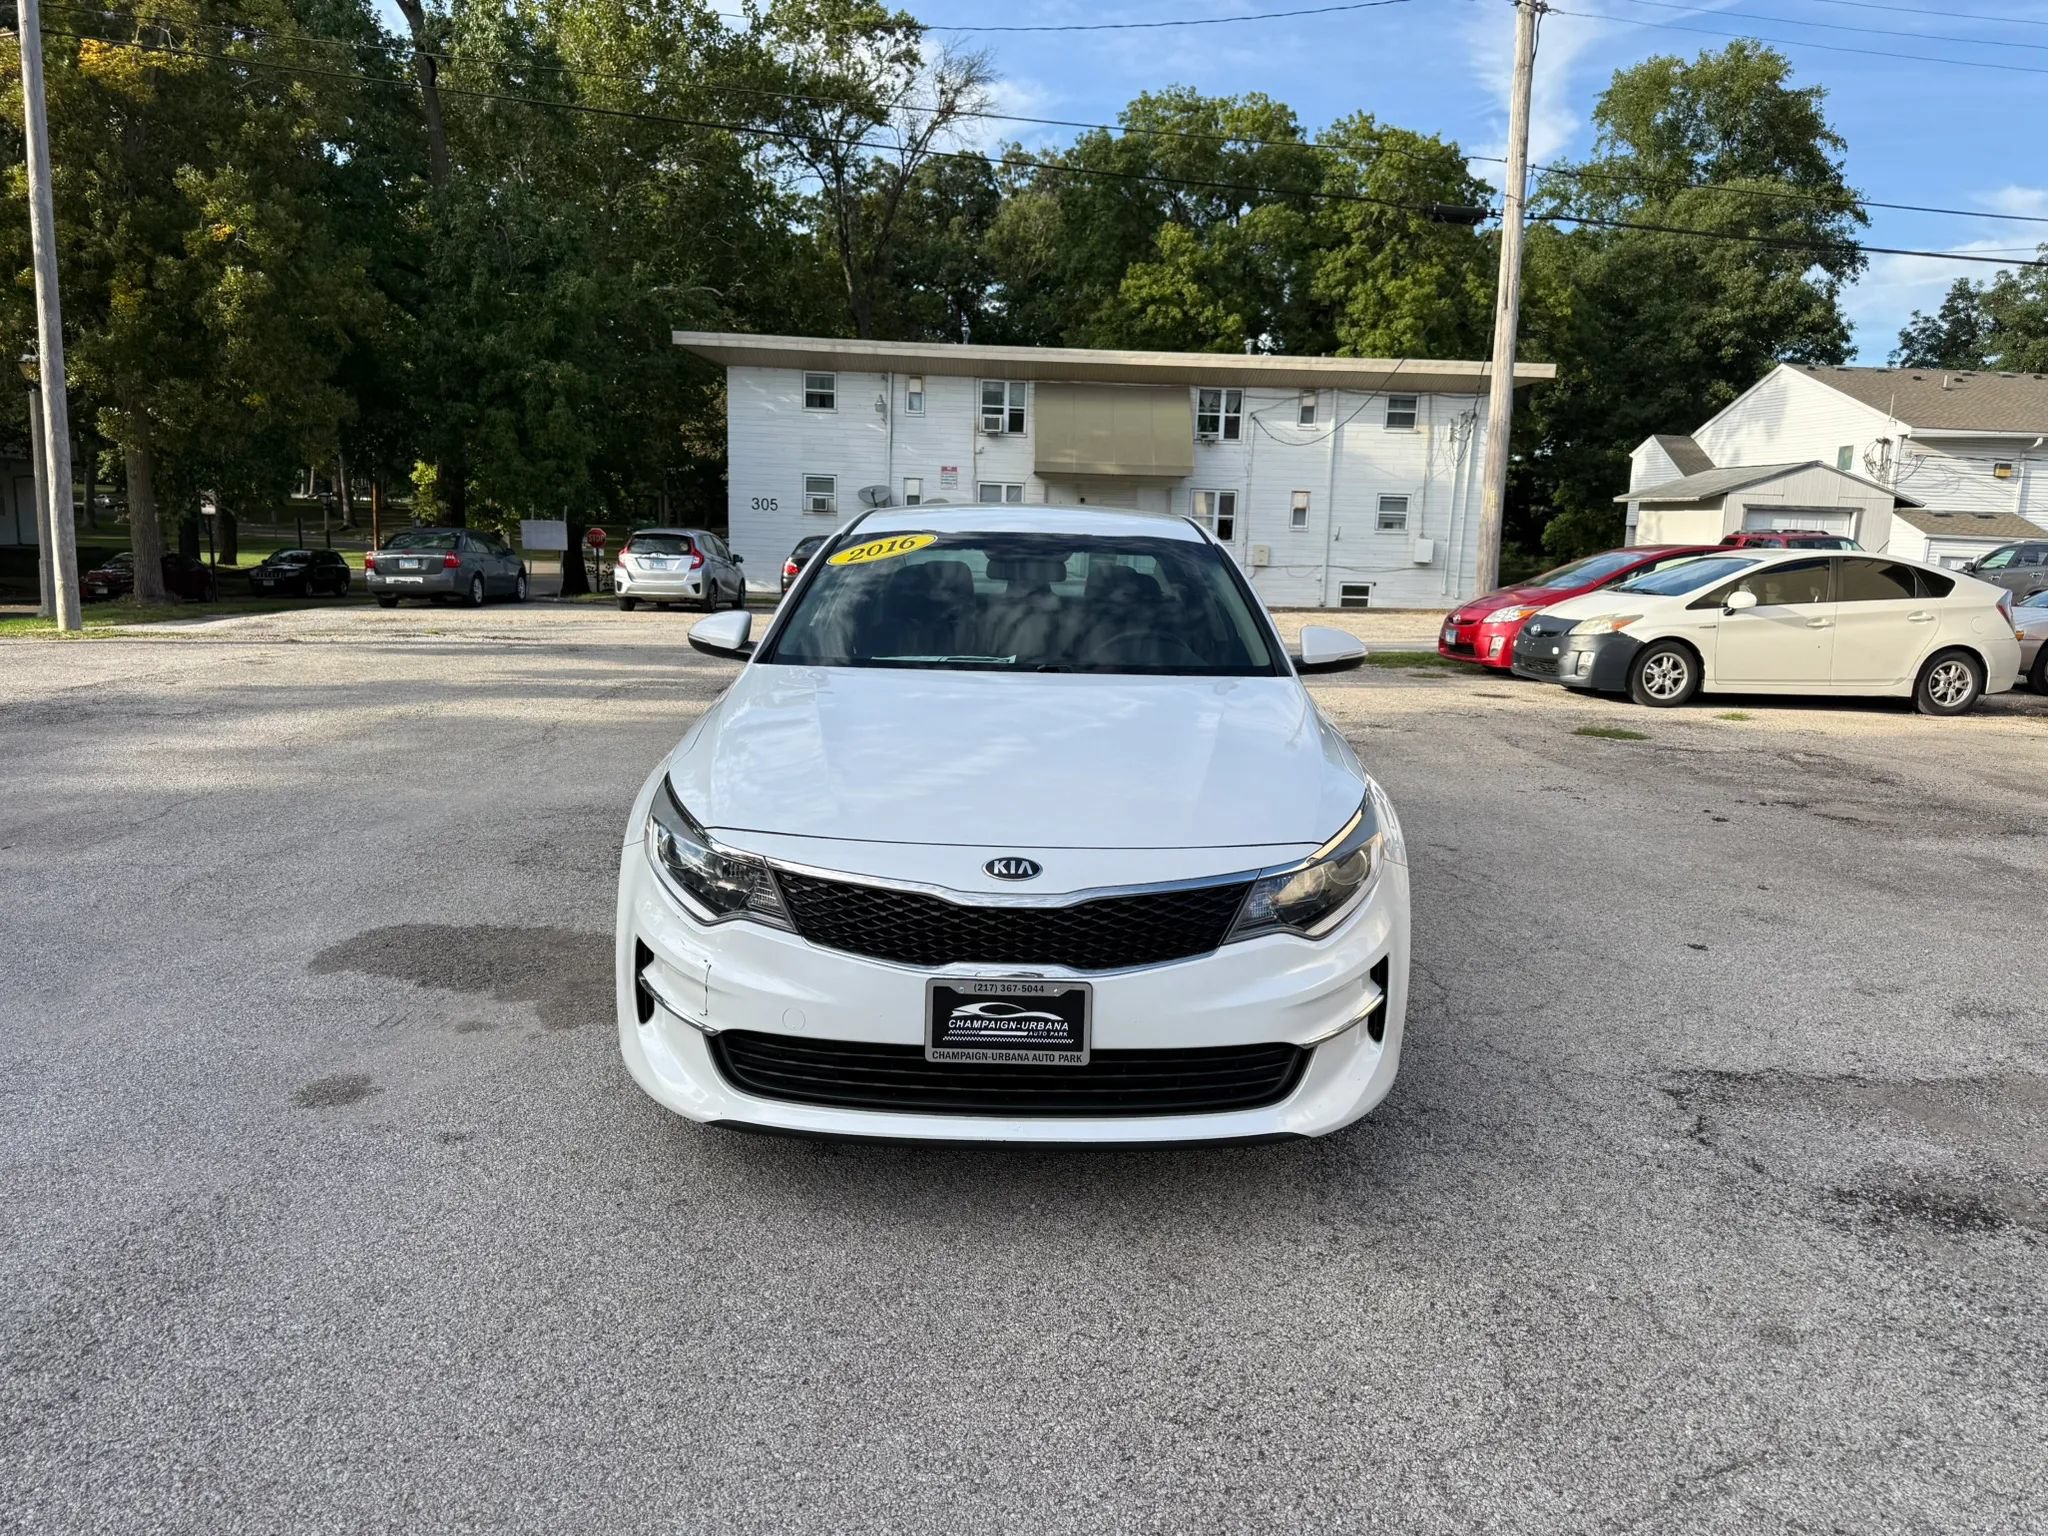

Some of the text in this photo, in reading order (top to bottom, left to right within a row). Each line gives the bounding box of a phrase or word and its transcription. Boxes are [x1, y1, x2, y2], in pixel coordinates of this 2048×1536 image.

[751, 497, 778, 511] 305
[847, 536, 917, 562] 2016
[993, 860, 1033, 875] KIA
[973, 983, 1044, 993] (217) 367-5044
[948, 1019, 1069, 1031] CHAMPAIGN-URBANA
[932, 1051, 1082, 1063] CHAMPAIGN-URBANA AUTO PARK
